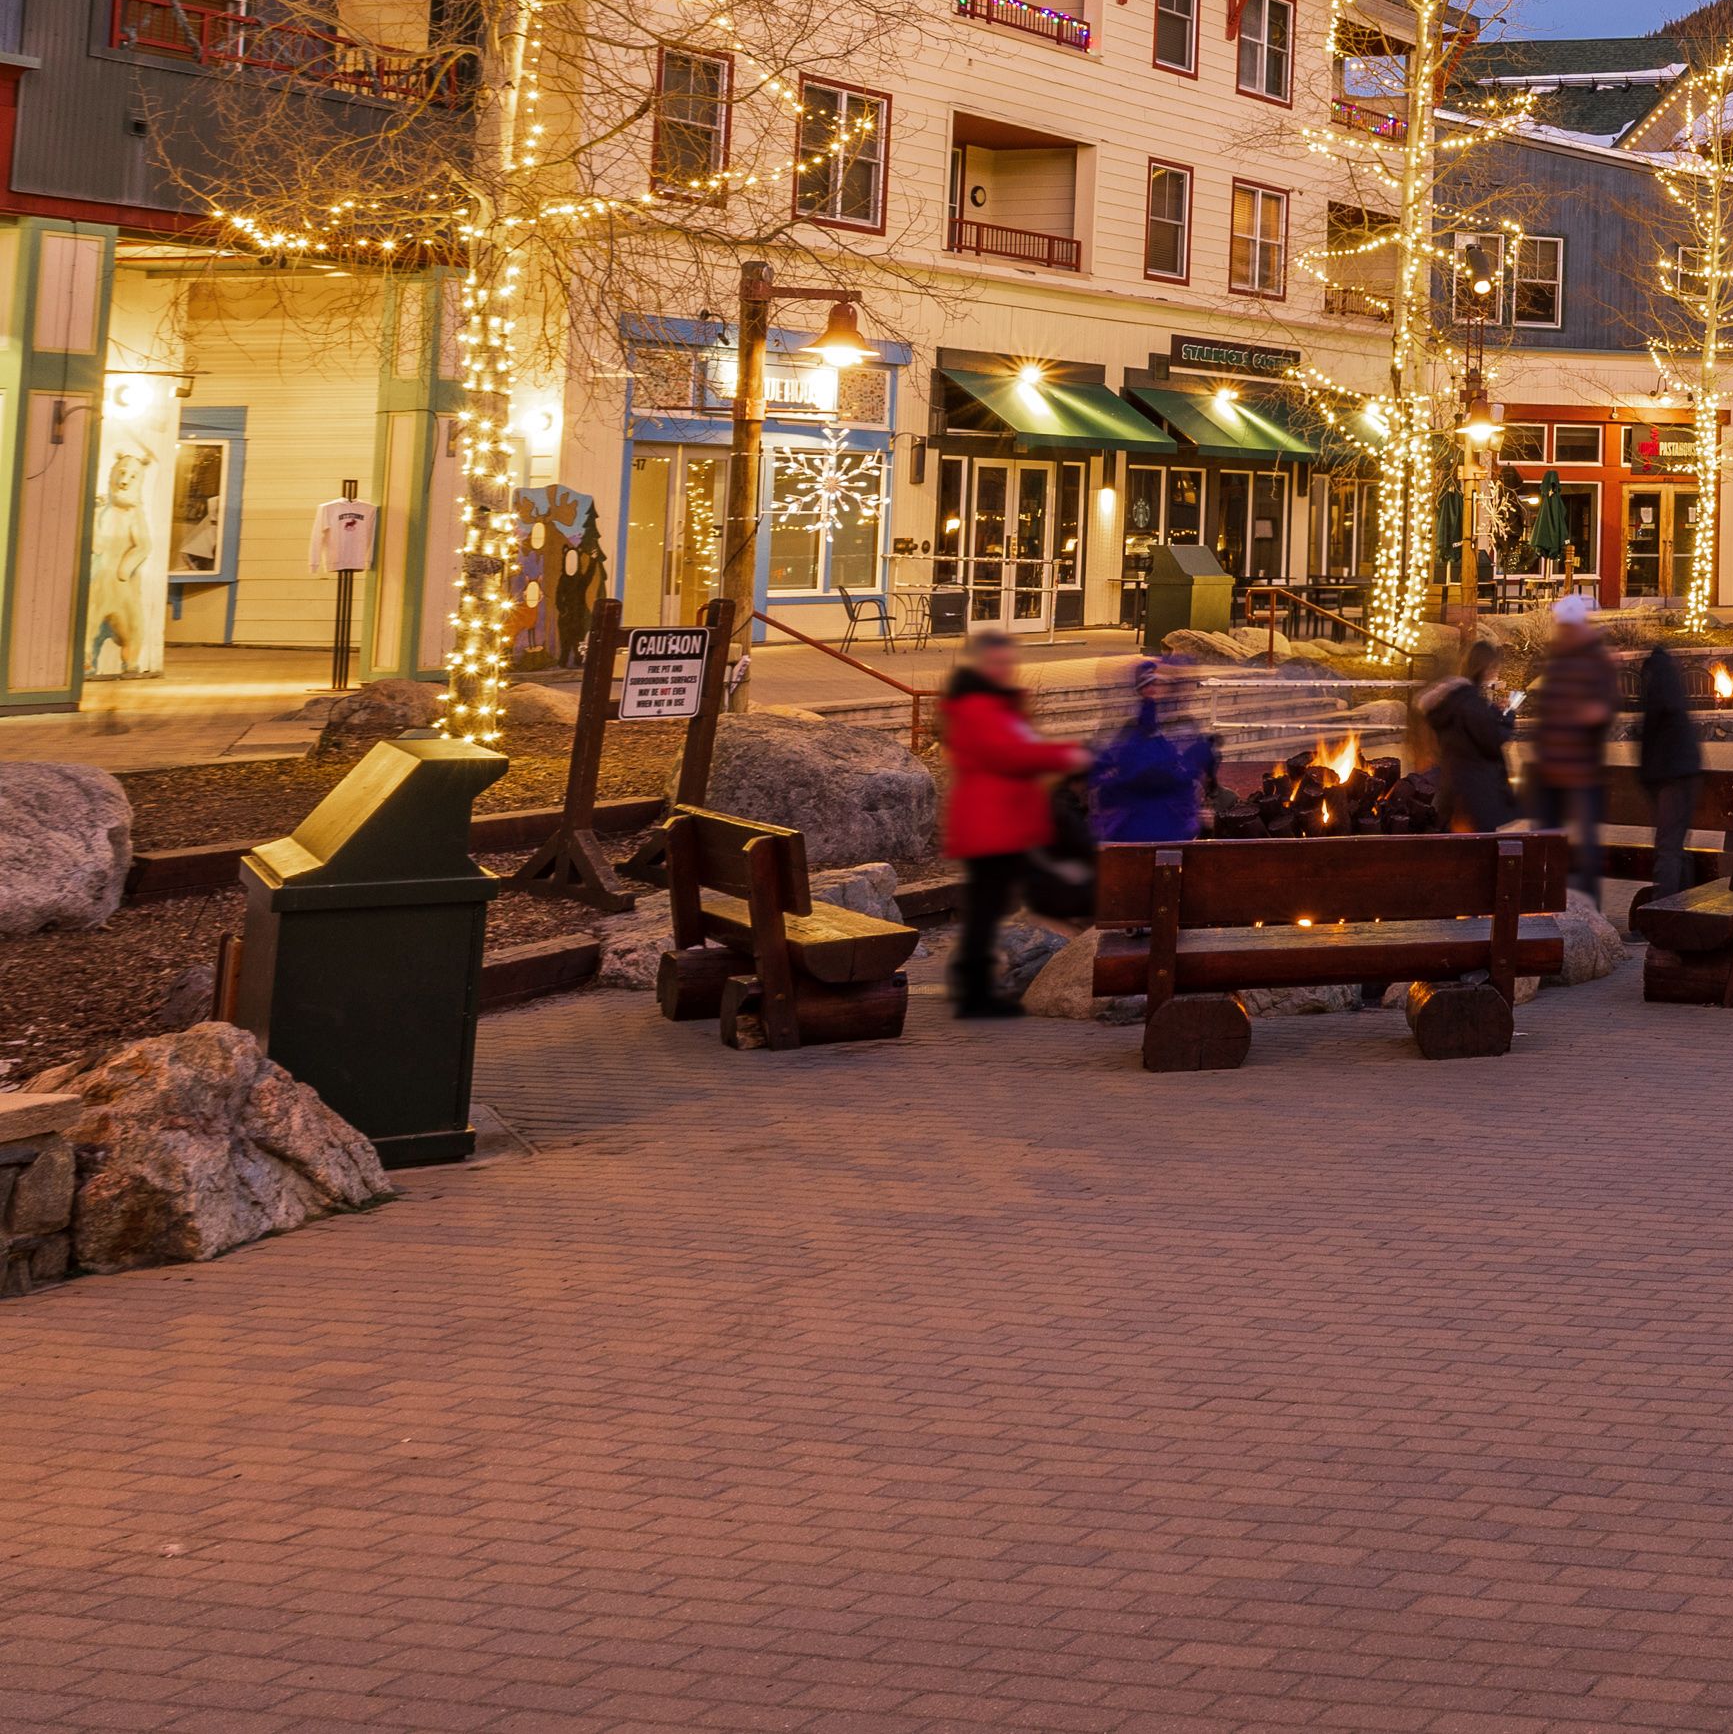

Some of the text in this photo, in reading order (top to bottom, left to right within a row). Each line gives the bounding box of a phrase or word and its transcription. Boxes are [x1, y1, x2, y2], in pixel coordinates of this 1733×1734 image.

[1181, 344, 1249, 366] STARBUCKS
[1659, 442, 1697, 456] PASTAHOUS
[629, 676, 698, 686] SURROUNDING SURFACES
[638, 688, 650, 696] MAY
[660, 688, 672, 696] HOT
[672, 687, 686, 696] EVEN
[674, 698, 685, 706] USE
